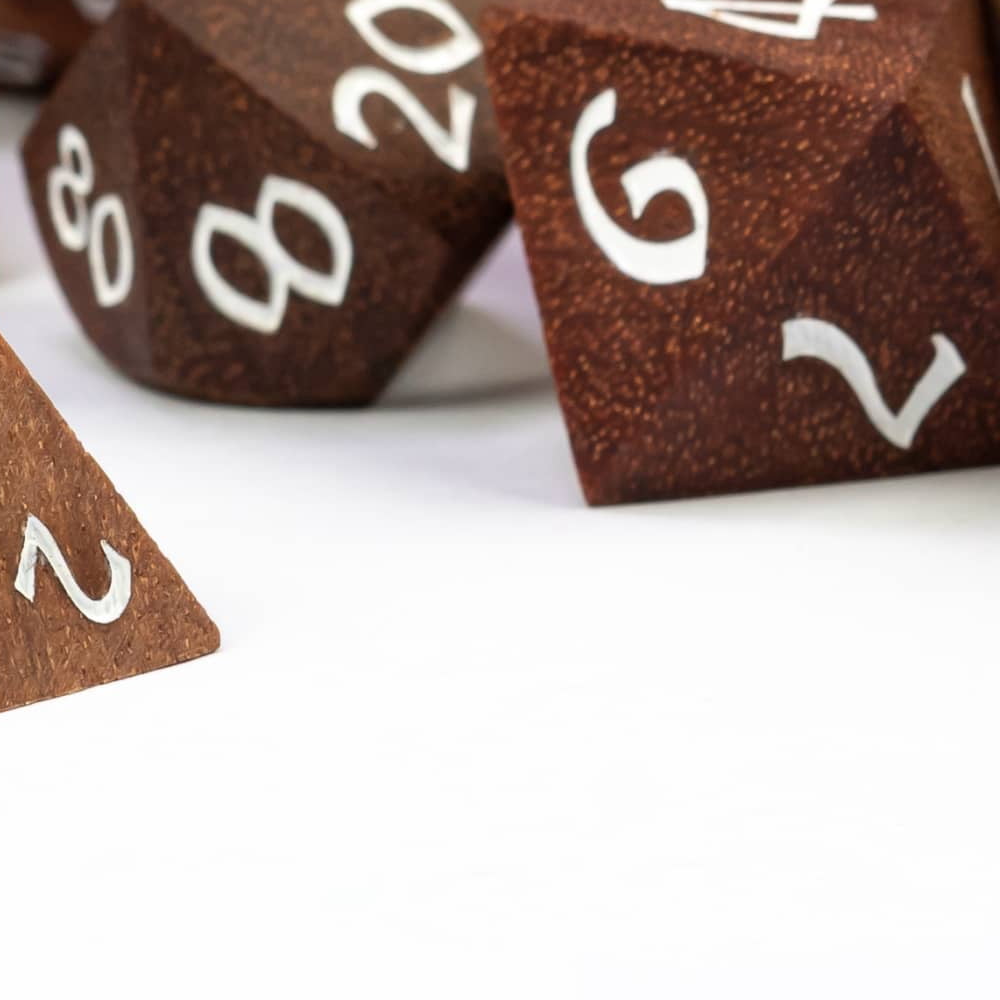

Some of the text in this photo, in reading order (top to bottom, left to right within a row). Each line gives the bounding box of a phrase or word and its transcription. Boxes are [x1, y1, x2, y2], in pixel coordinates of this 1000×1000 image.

[47, 125, 134, 307] 80
[191, 175, 353, 334] 8
[570, 88, 709, 285] 6
[13, 513, 133, 625] 2
